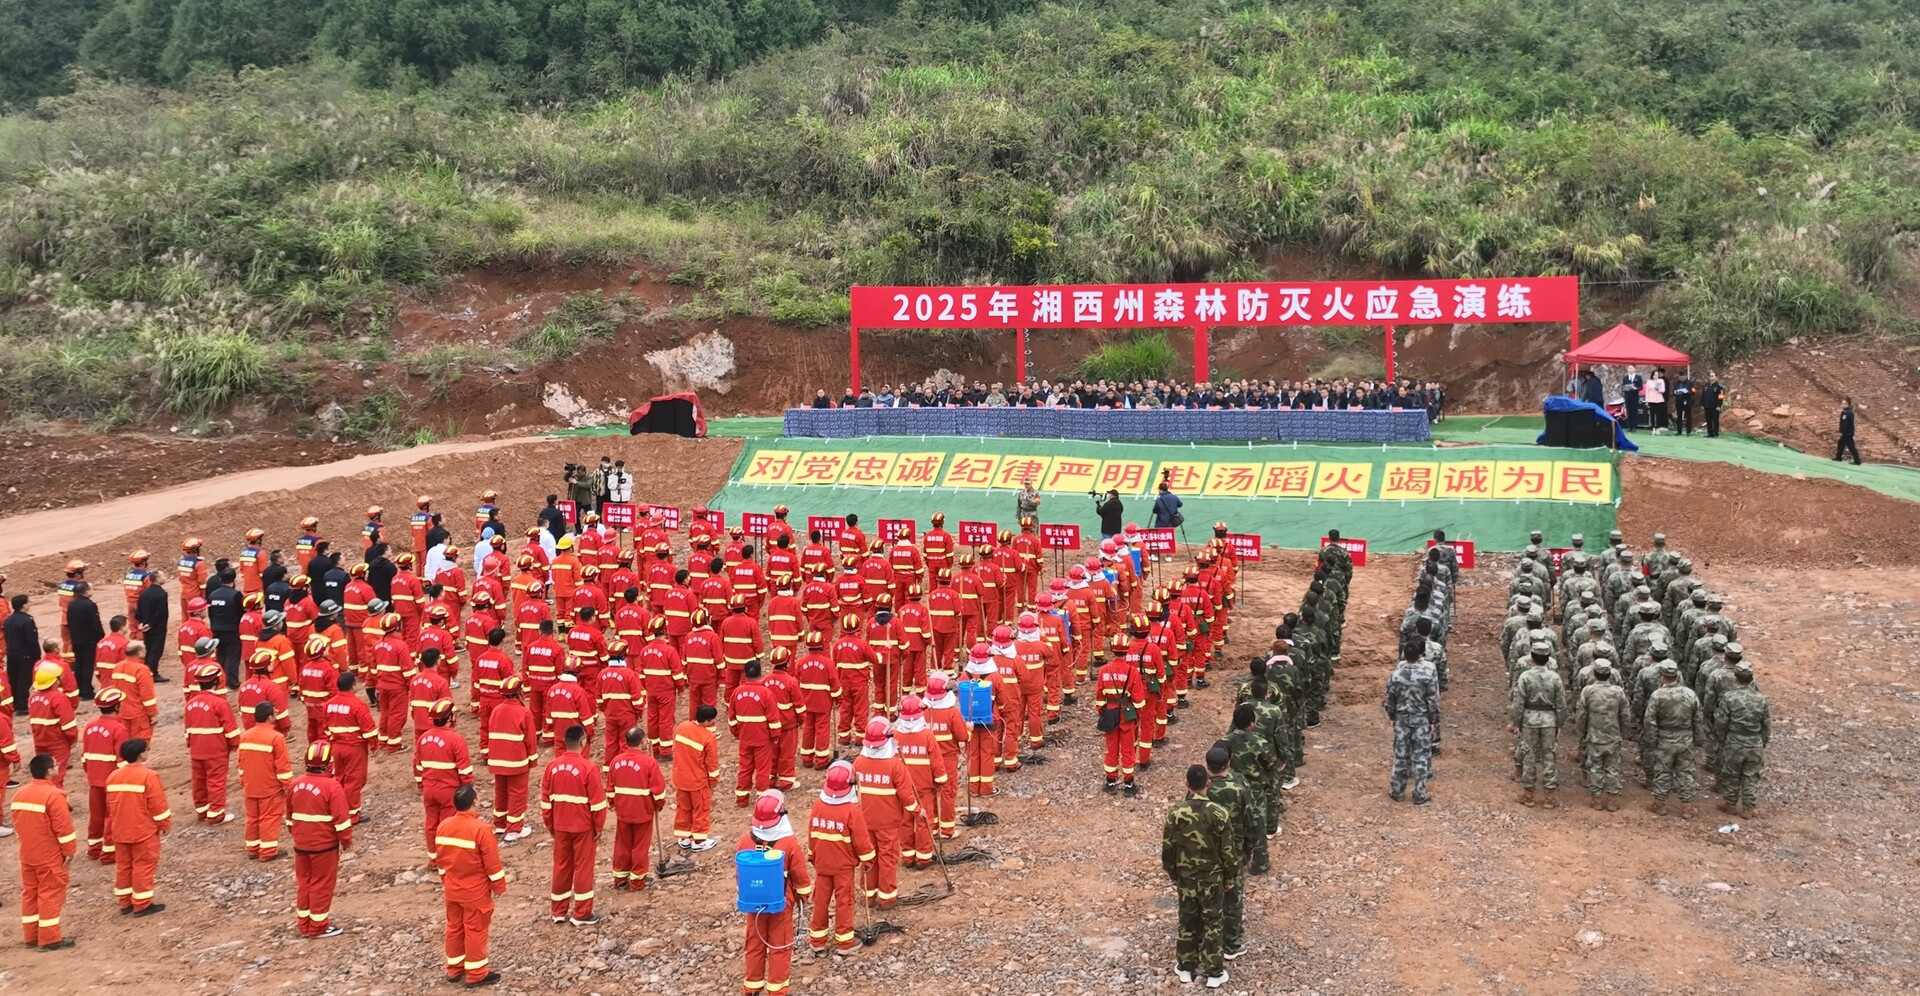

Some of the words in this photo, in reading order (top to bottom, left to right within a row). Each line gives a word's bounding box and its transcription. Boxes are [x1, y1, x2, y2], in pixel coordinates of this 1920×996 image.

[892, 284, 1532, 323] 2025年湘西州森林防灭火应急演练
[749, 453, 944, 483] 对党忠诚
[948, 458, 1147, 490] 纪律严明
[1158, 466, 1362, 494] 赴汤蹈火
[1386, 465, 1603, 496] 竭诚为民
[900, 745, 926, 754] 林消防
[858, 772, 890, 784] 森林消防
[812, 817, 844, 832] 森林消防
